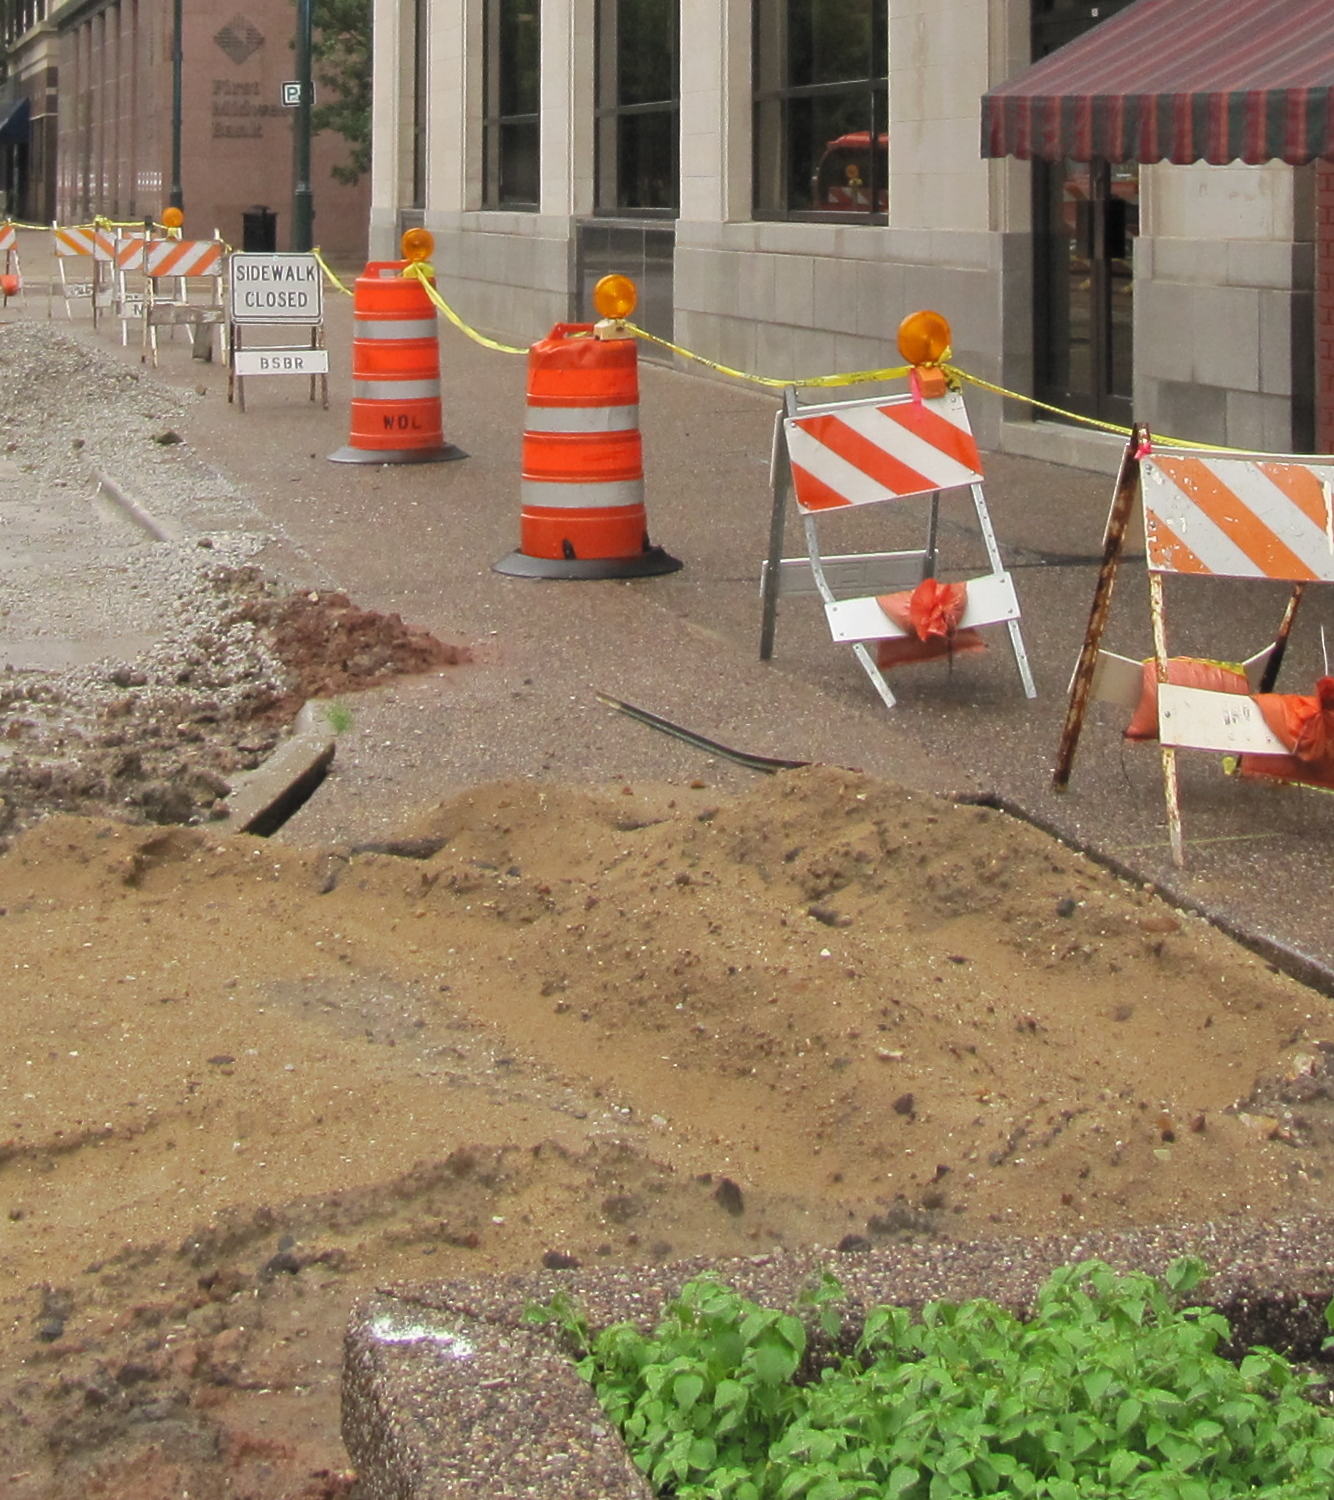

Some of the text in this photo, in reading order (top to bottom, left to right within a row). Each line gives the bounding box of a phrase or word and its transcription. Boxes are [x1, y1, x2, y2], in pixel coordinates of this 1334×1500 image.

[236, 265, 315, 281] SIDEWALK
[245, 291, 308, 308] CLOSED
[260, 356, 304, 370] BSBR
